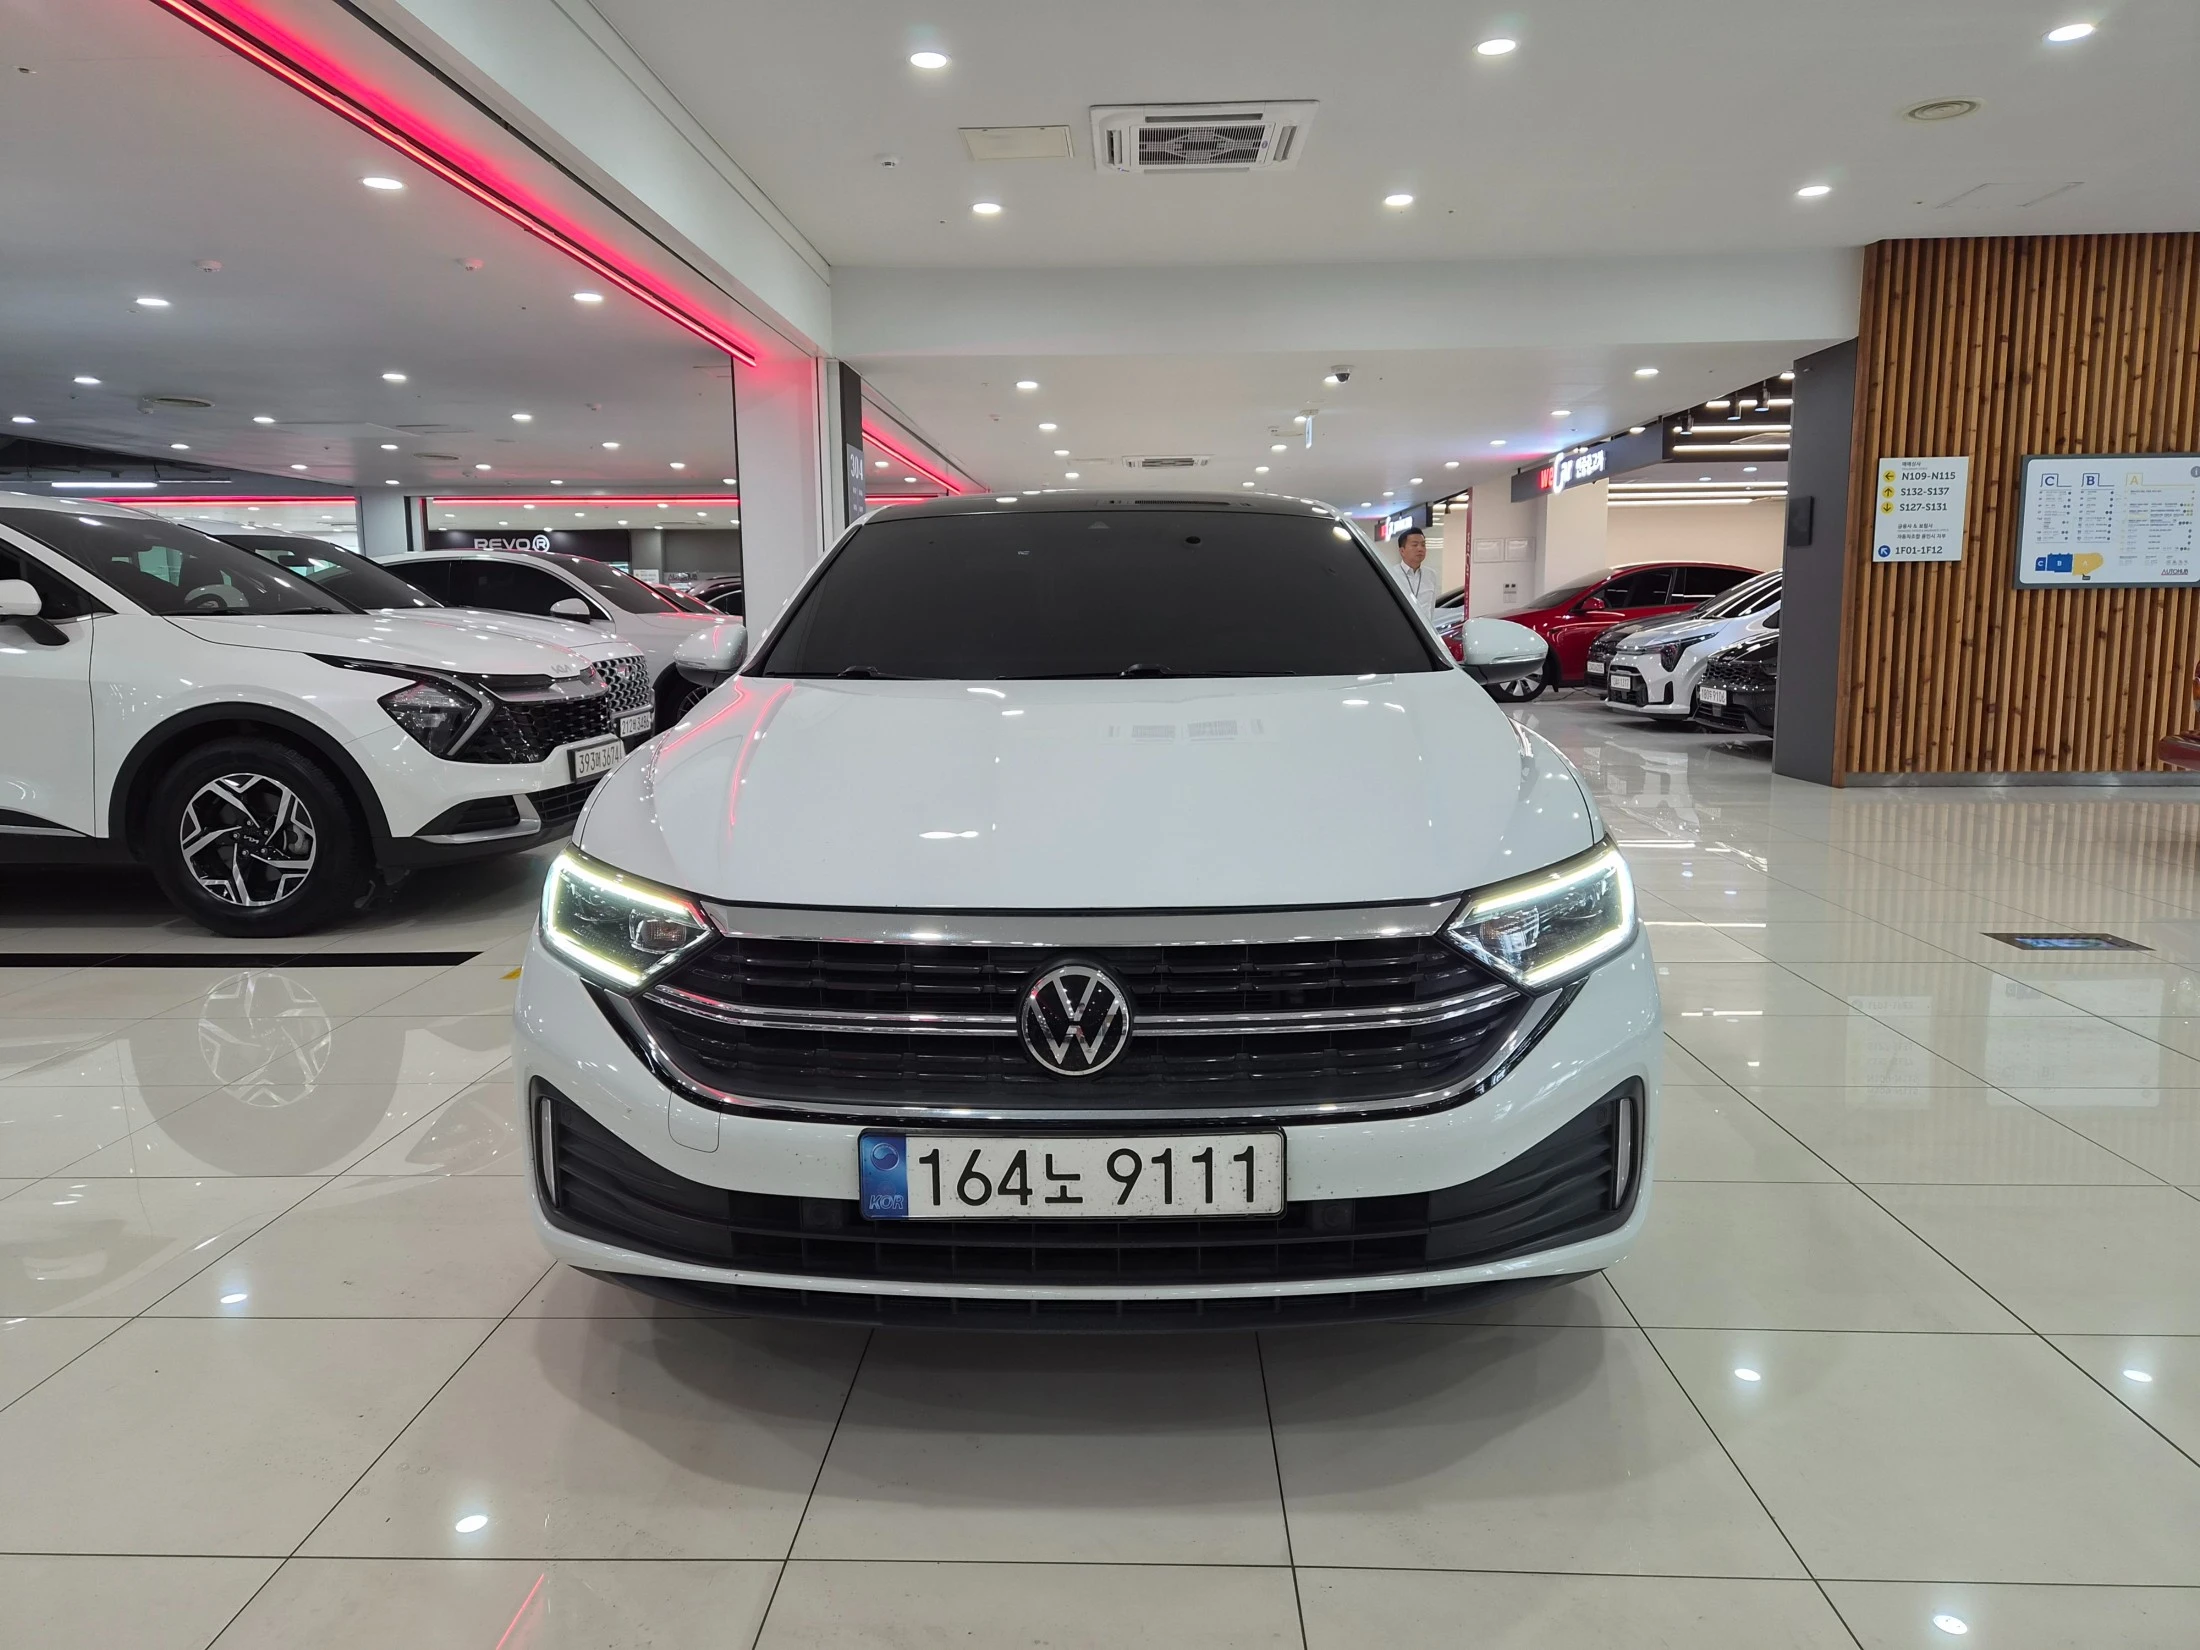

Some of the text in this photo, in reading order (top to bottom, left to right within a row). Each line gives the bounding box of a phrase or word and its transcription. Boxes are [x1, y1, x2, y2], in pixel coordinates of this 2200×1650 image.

[1901, 471, 1956, 481] N109-N115
[2044, 476, 2055, 486] C
[2086, 476, 2095, 486] B
[2130, 475, 2139, 485] A
[1900, 487, 1950, 496] S132-S137
[1899, 503, 1947, 512] S127-S131
[1895, 546, 1943, 555] 1F01-1F12
[2161, 568, 2189, 576] AUTOHUB
[918, 1145, 1255, 1206] 164노 9111
[868, 1194, 905, 1210] KOR
